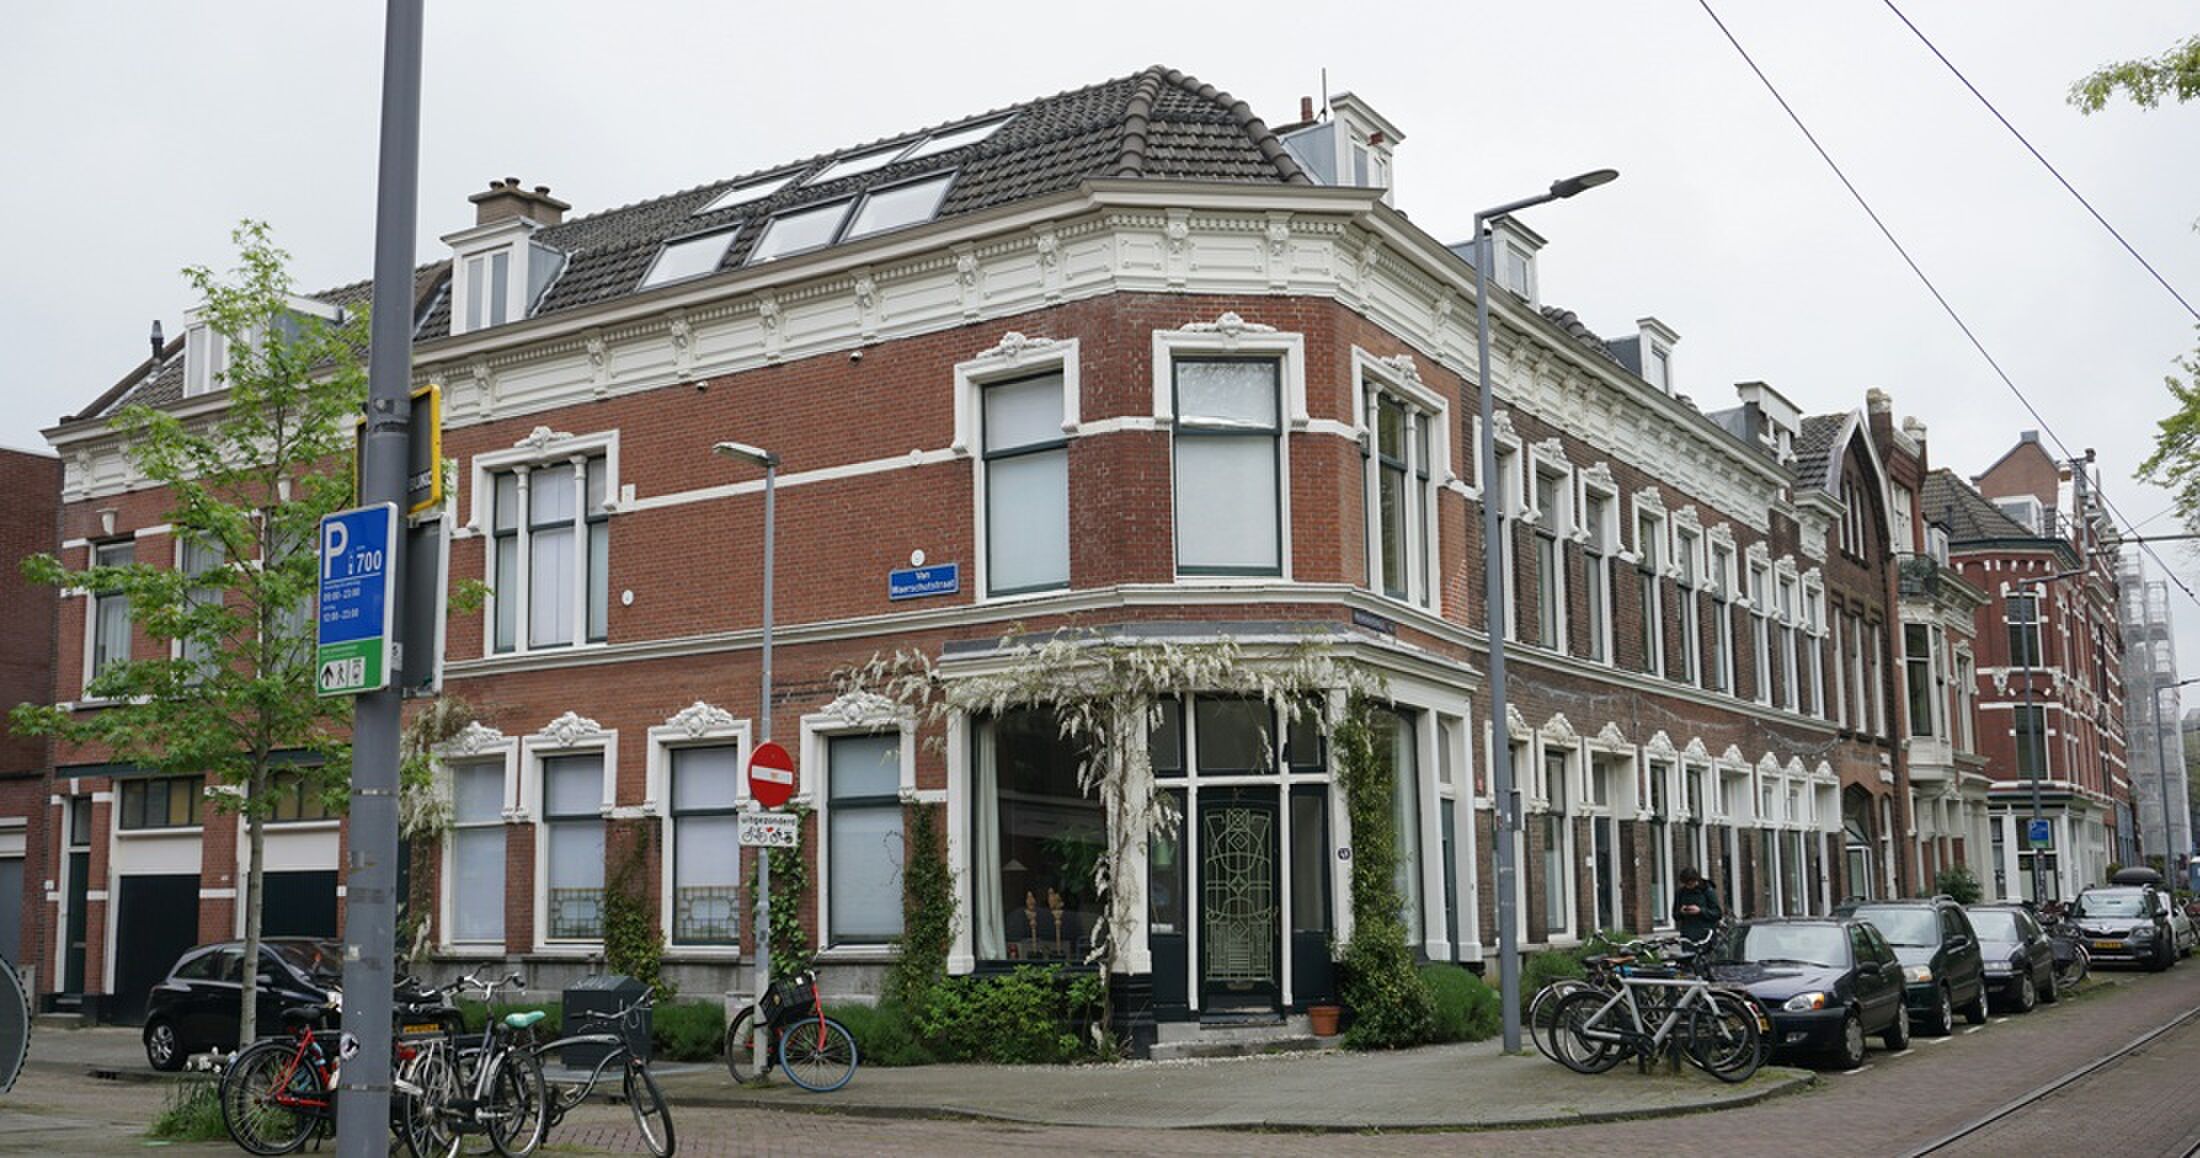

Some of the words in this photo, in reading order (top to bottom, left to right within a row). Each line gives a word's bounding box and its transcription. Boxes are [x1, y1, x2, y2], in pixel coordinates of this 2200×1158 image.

[324, 521, 349, 579] P
[356, 549, 382, 574] 700
[915, 571, 931, 581] Van
[741, 815, 796, 827] uitgezonderd
